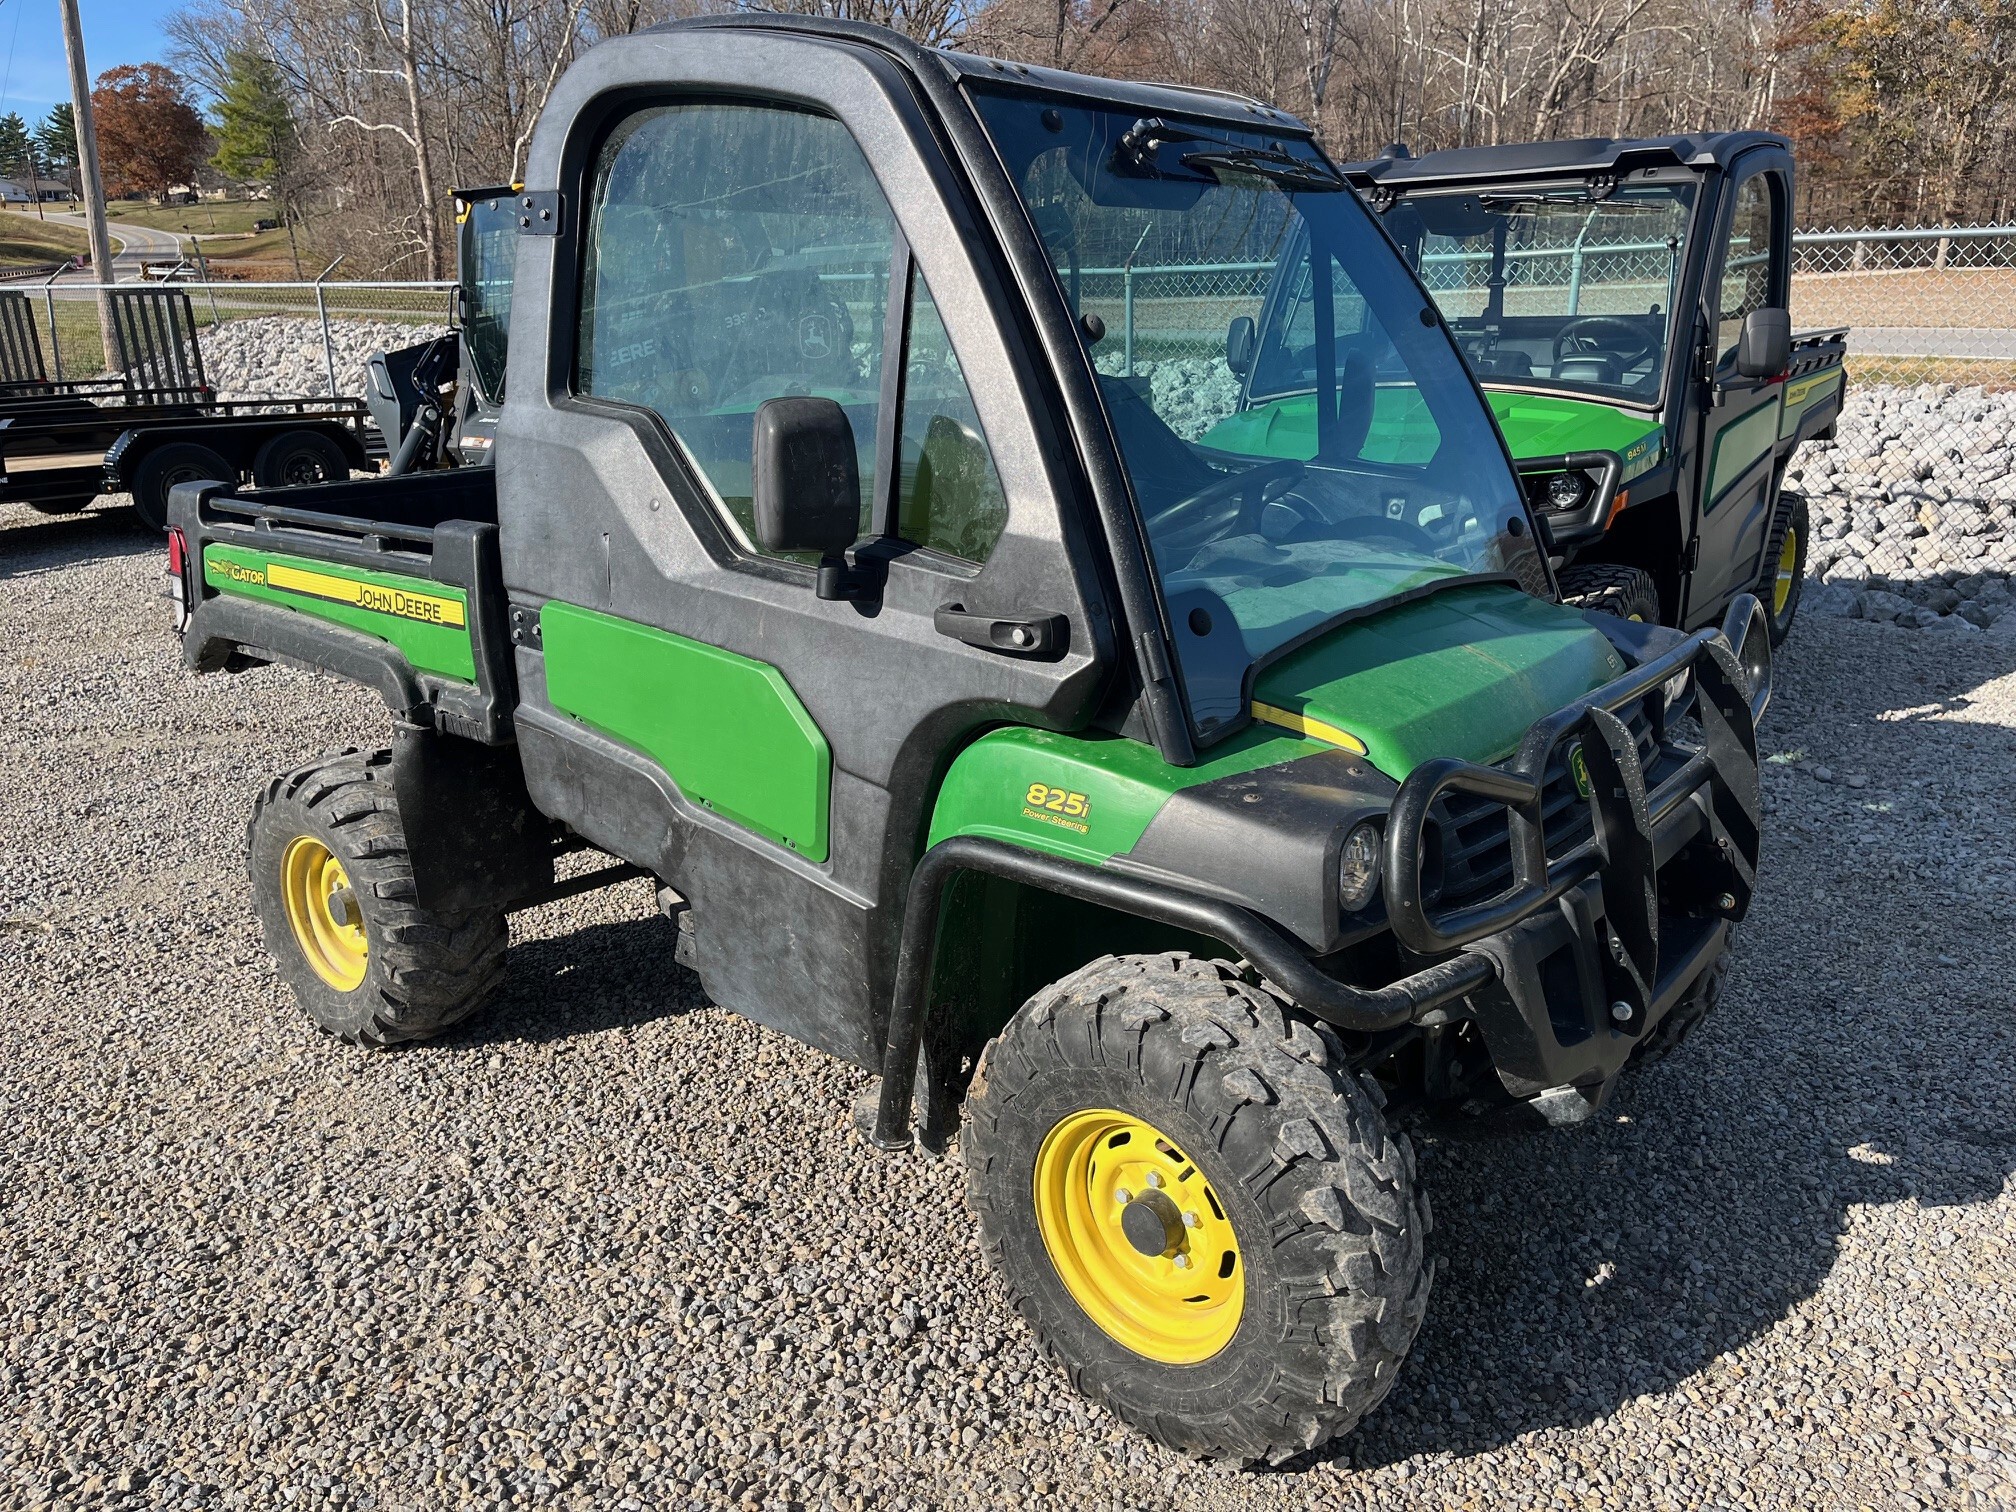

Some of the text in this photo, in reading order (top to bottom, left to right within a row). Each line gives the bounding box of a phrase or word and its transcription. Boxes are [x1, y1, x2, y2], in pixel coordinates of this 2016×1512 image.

[609, 338, 656, 368] EERE
[231, 564, 265, 586] GATOR
[355, 585, 442, 621] JOHN DEERE
[1026, 782, 1090, 818] 825i
[1023, 807, 1090, 833] Power Steering
